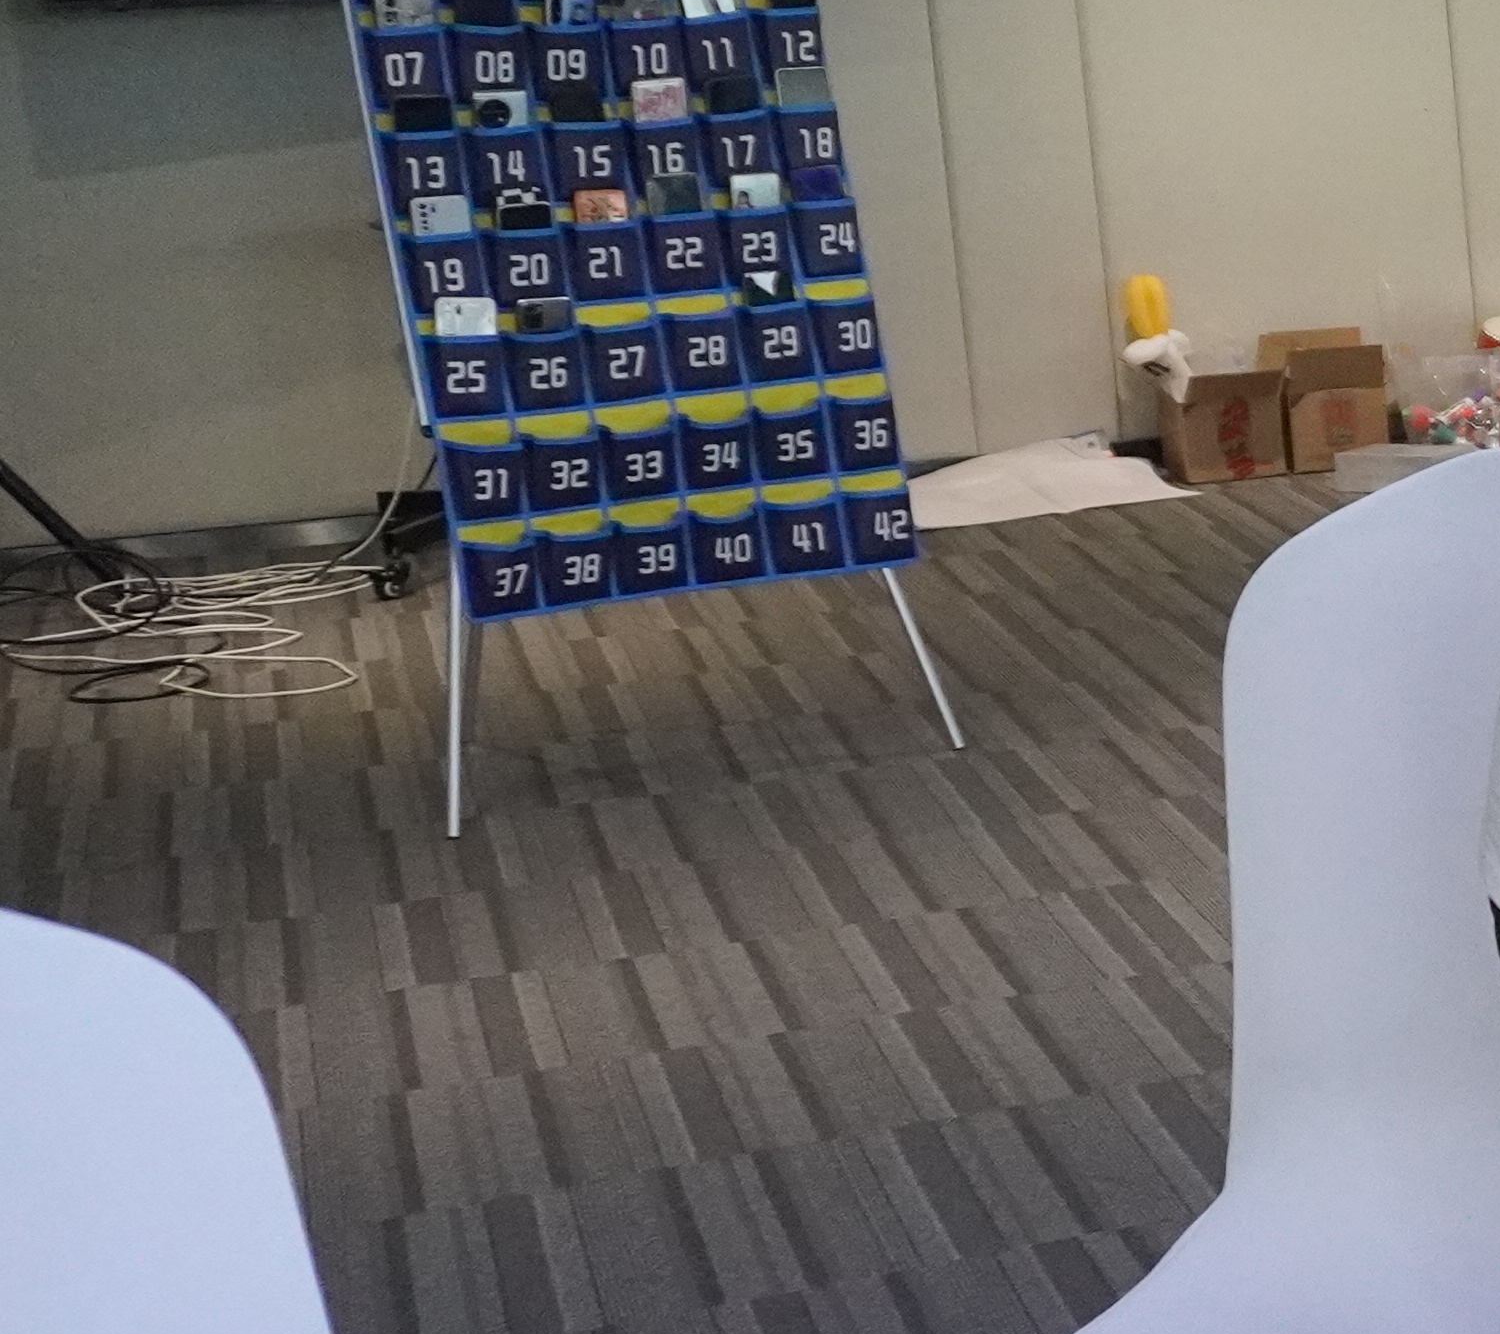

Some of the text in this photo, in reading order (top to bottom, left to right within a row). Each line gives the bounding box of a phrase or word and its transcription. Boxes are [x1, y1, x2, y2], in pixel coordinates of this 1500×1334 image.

[385, 30, 816, 87] 07 08 09 10 11 12
[406, 127, 833, 189] 13 14 15 16 17 18
[424, 222, 855, 293] 19 20 21 22 23 24
[447, 318, 872, 394] 25 26 27 28 29 30
[475, 418, 887, 500] 31 32 33 34 35 36
[495, 509, 909, 597] 37 38 39 40 41 42
